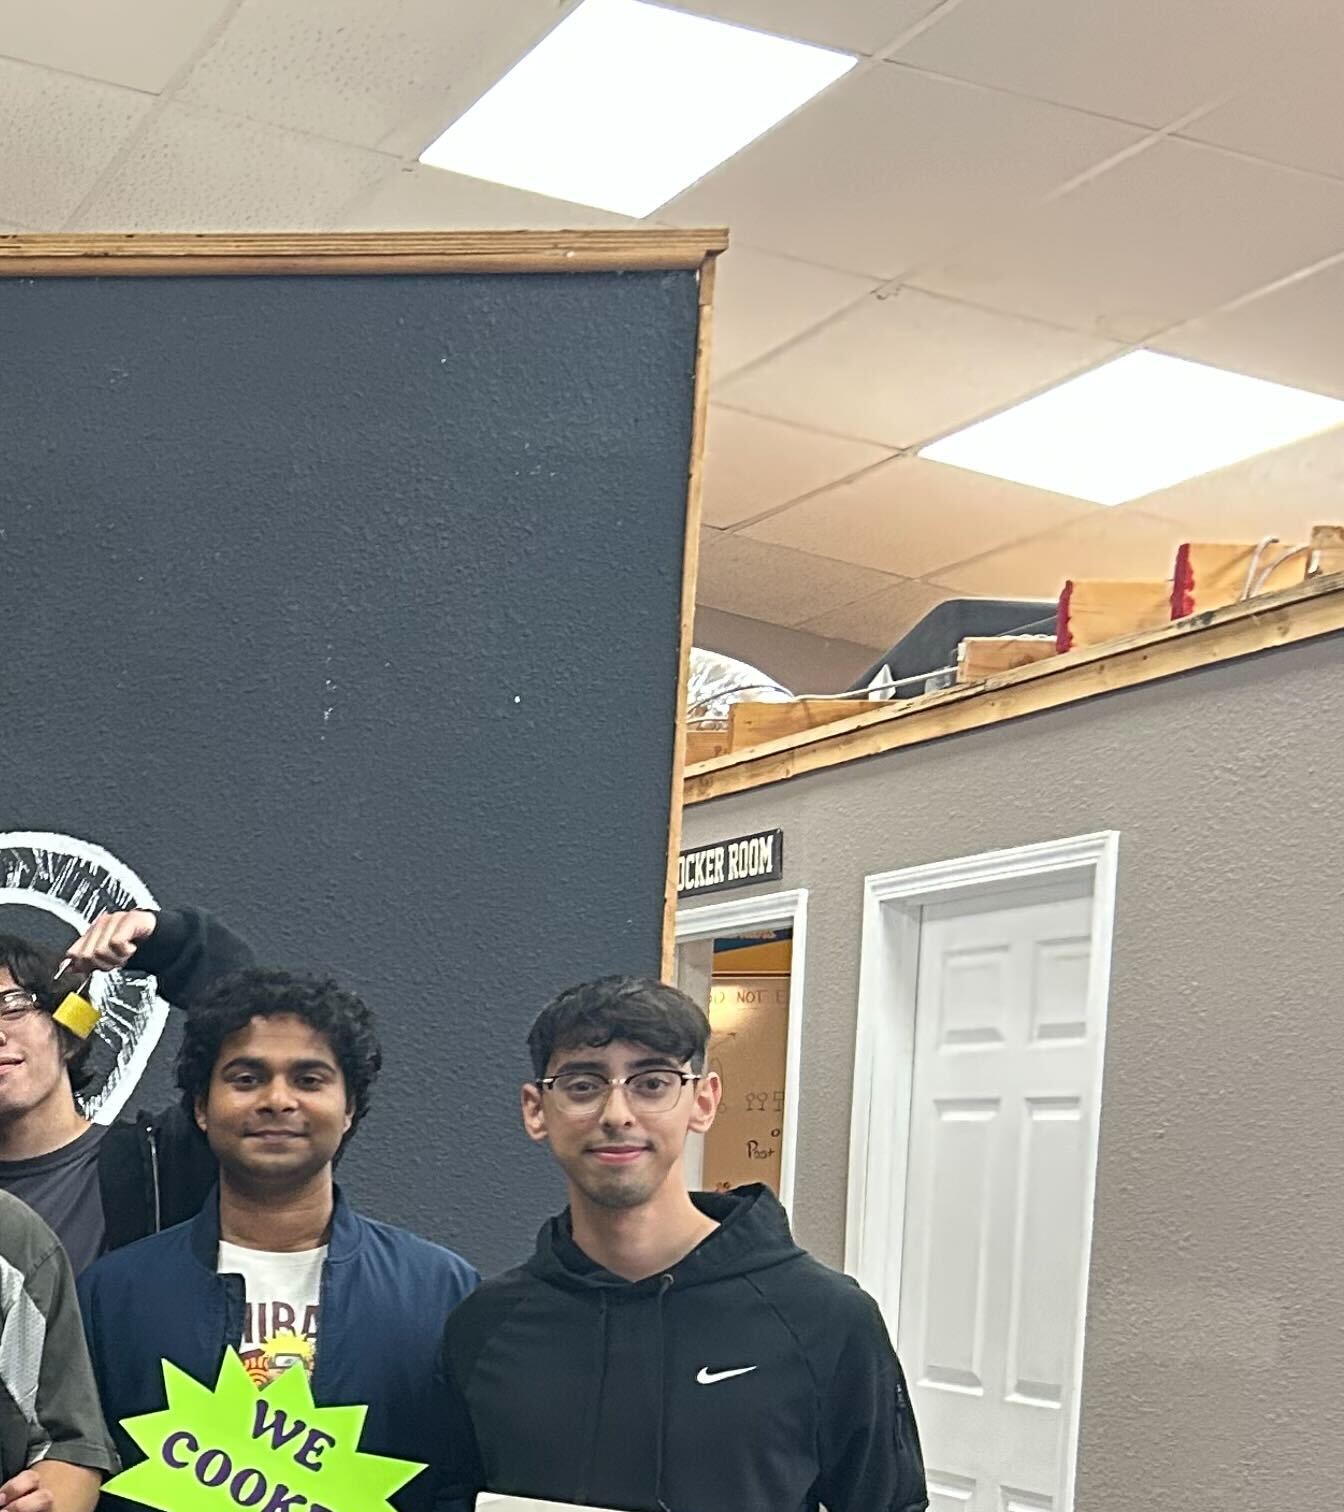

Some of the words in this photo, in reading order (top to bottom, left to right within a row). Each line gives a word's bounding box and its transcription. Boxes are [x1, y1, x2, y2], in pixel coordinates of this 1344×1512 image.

[677, 847, 724, 891] OCKER
[728, 835, 773, 880] ROOM
[252, 1400, 335, 1472] WE
